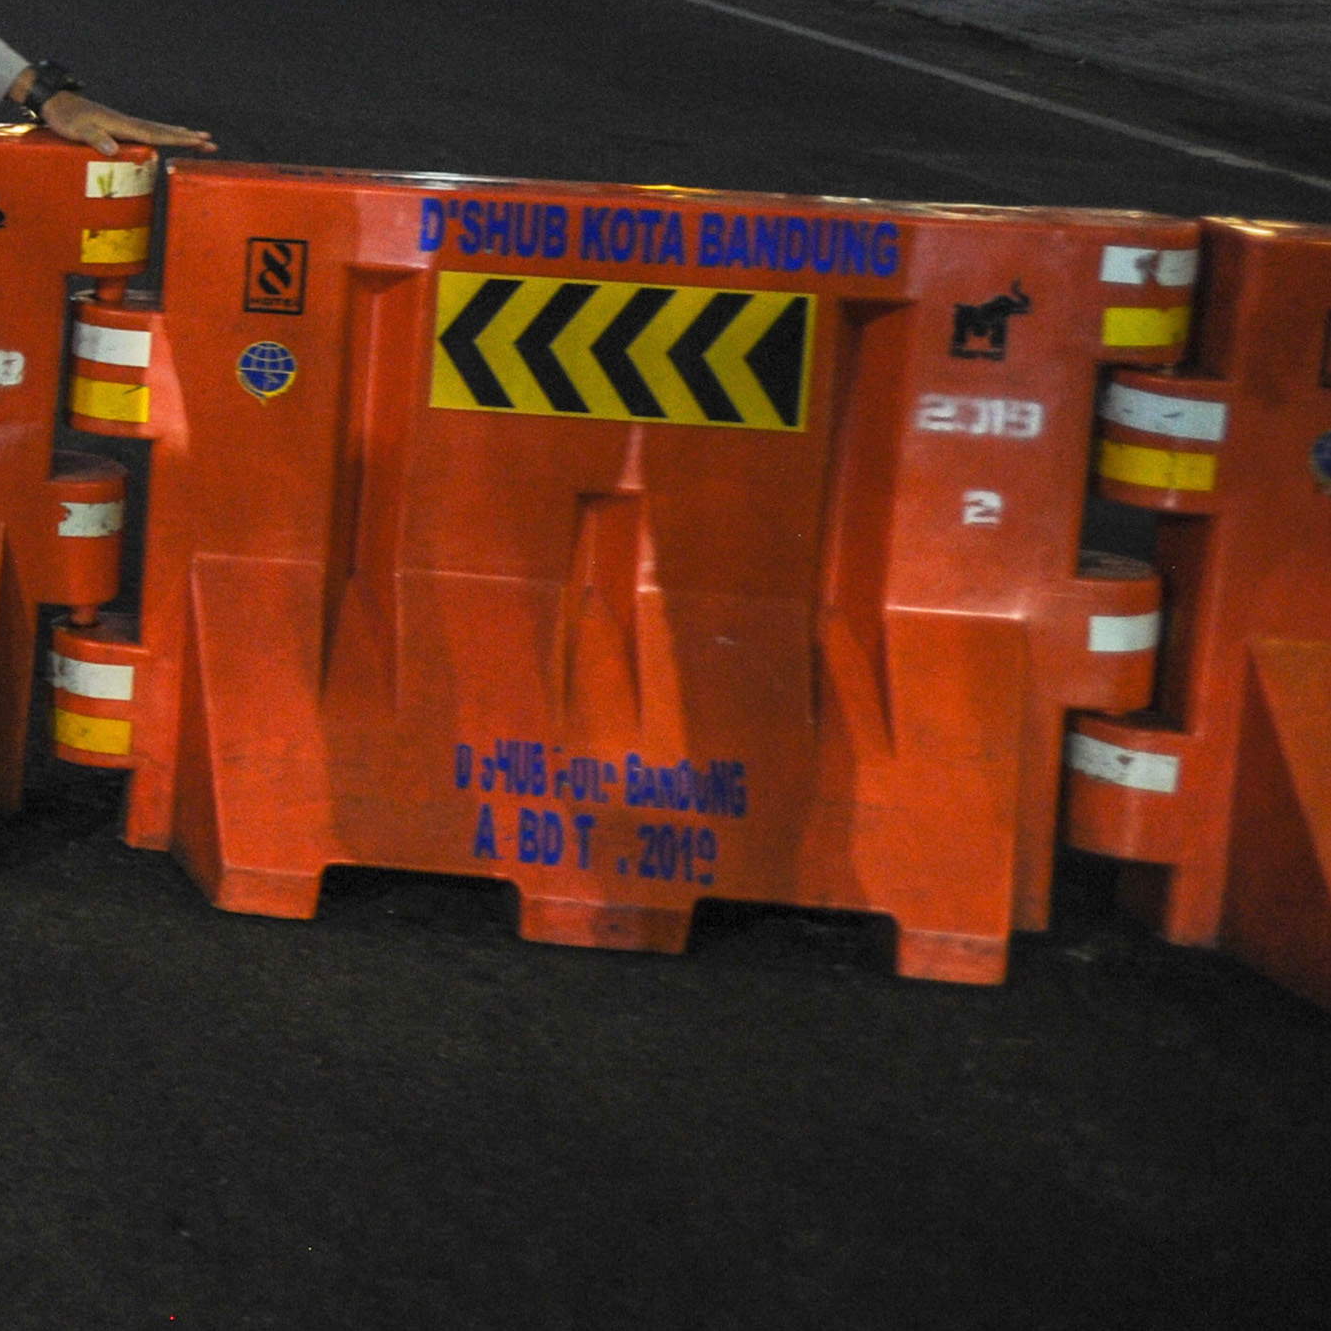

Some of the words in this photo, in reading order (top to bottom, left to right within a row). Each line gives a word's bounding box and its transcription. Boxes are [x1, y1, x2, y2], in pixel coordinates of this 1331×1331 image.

[580, 206, 686, 267] KOTA
[697, 212, 901, 278] BANDUNG
[962, 489, 1003, 526] 2
[472, 803, 564, 866] ABD
